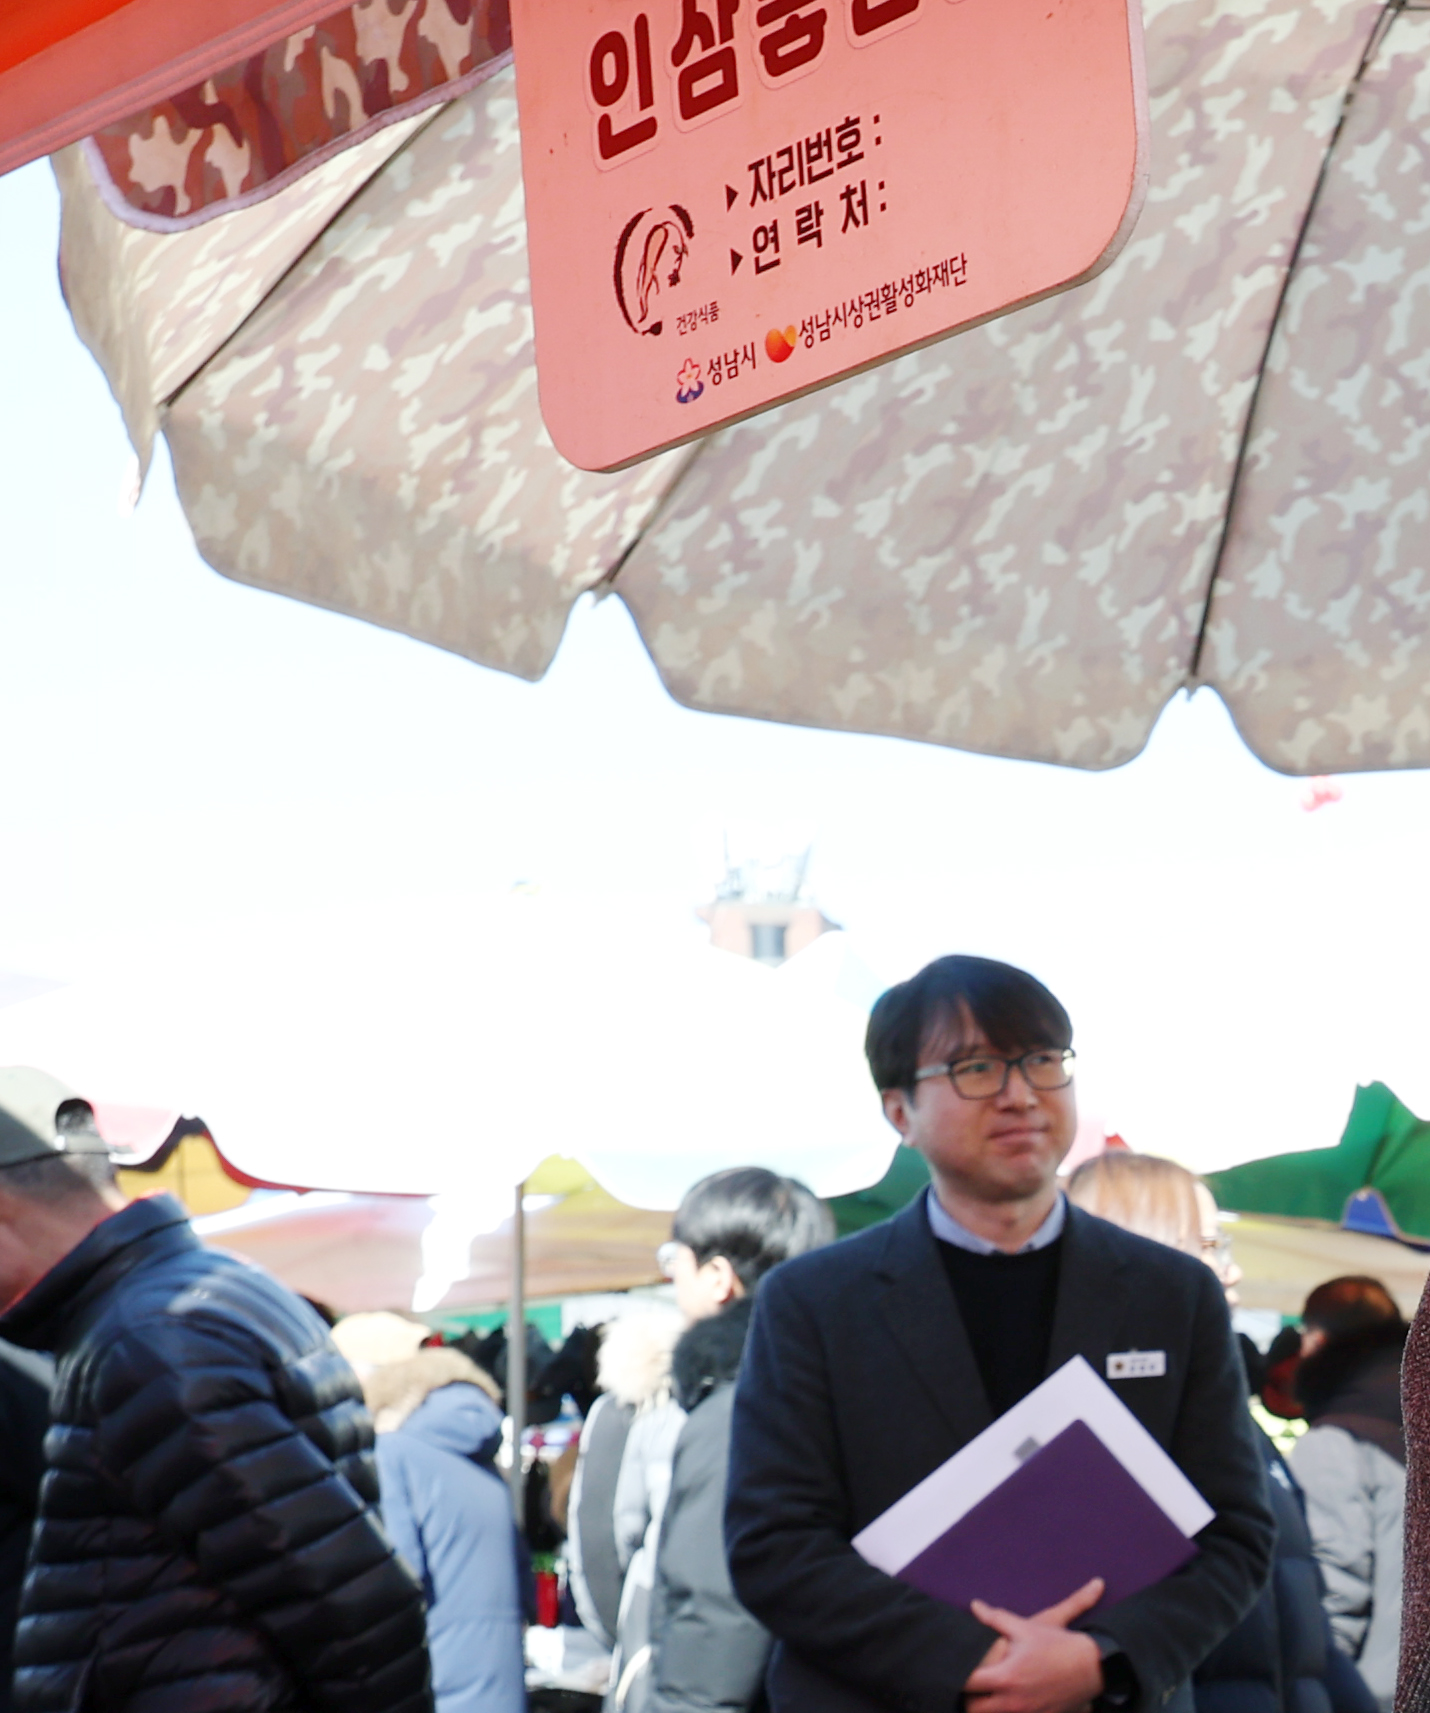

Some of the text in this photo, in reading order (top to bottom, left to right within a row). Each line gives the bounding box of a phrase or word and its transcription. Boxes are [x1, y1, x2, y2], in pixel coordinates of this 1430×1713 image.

[676, 301, 719, 335] 건강식품
[707, 252, 967, 385] 성남시 성남시상권활성화재단
